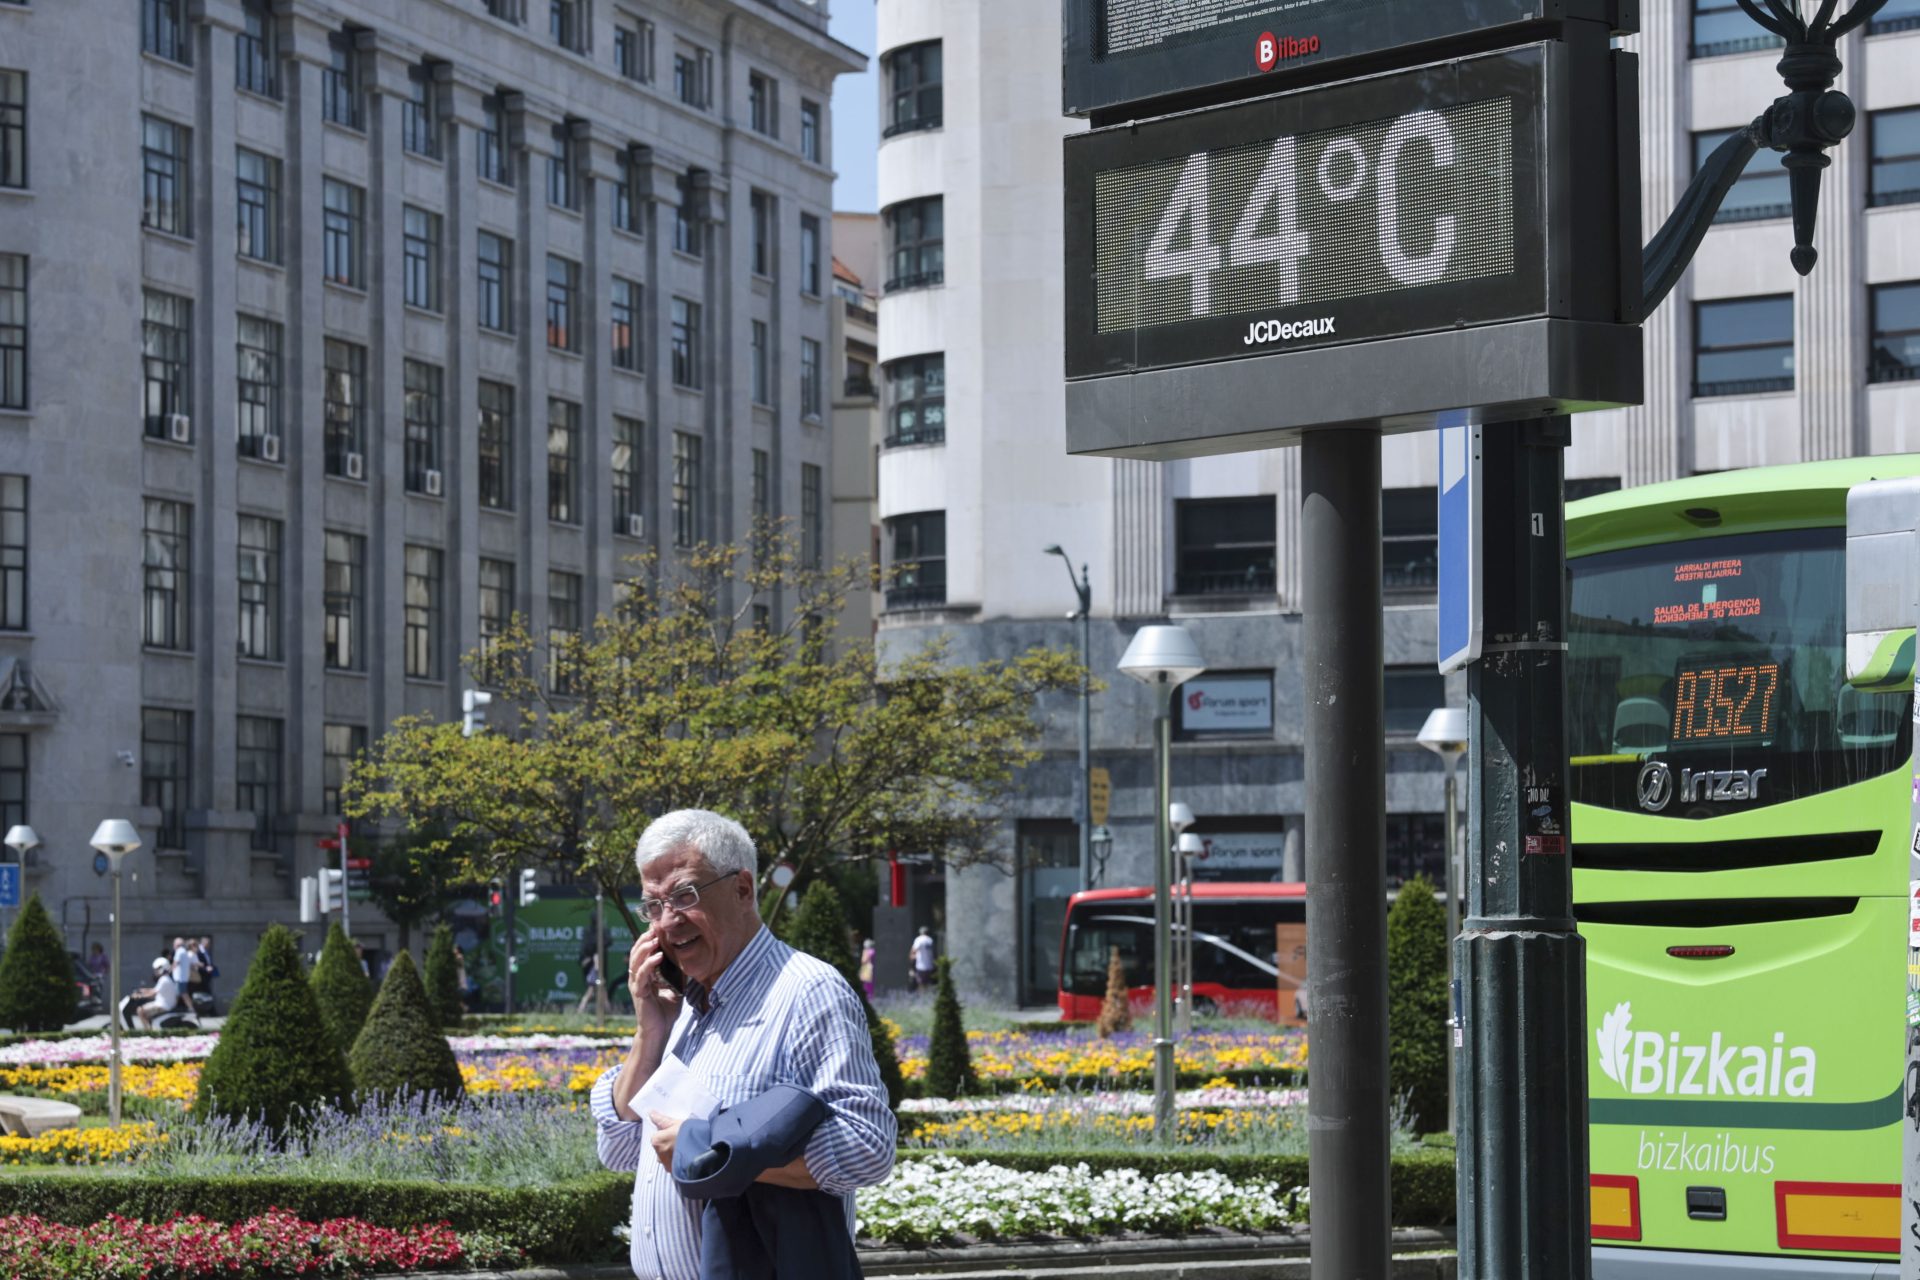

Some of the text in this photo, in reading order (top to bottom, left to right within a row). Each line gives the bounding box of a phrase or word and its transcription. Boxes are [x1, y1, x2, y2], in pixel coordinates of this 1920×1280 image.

[1260, 36, 1319, 63] Bilbao
[1243, 317, 1335, 345] JCDecaux
[1675, 559, 1742, 574] LARRIALDI IRTEERA
[1654, 598, 1760, 616] SALIDA DE EMERGENCIA
[1673, 664, 1778, 739] A3527
[530, 927, 573, 940] BILBAO
[1631, 1031, 1816, 1096] Bizkaia
[1637, 1131, 1776, 1175] bizkaibus
